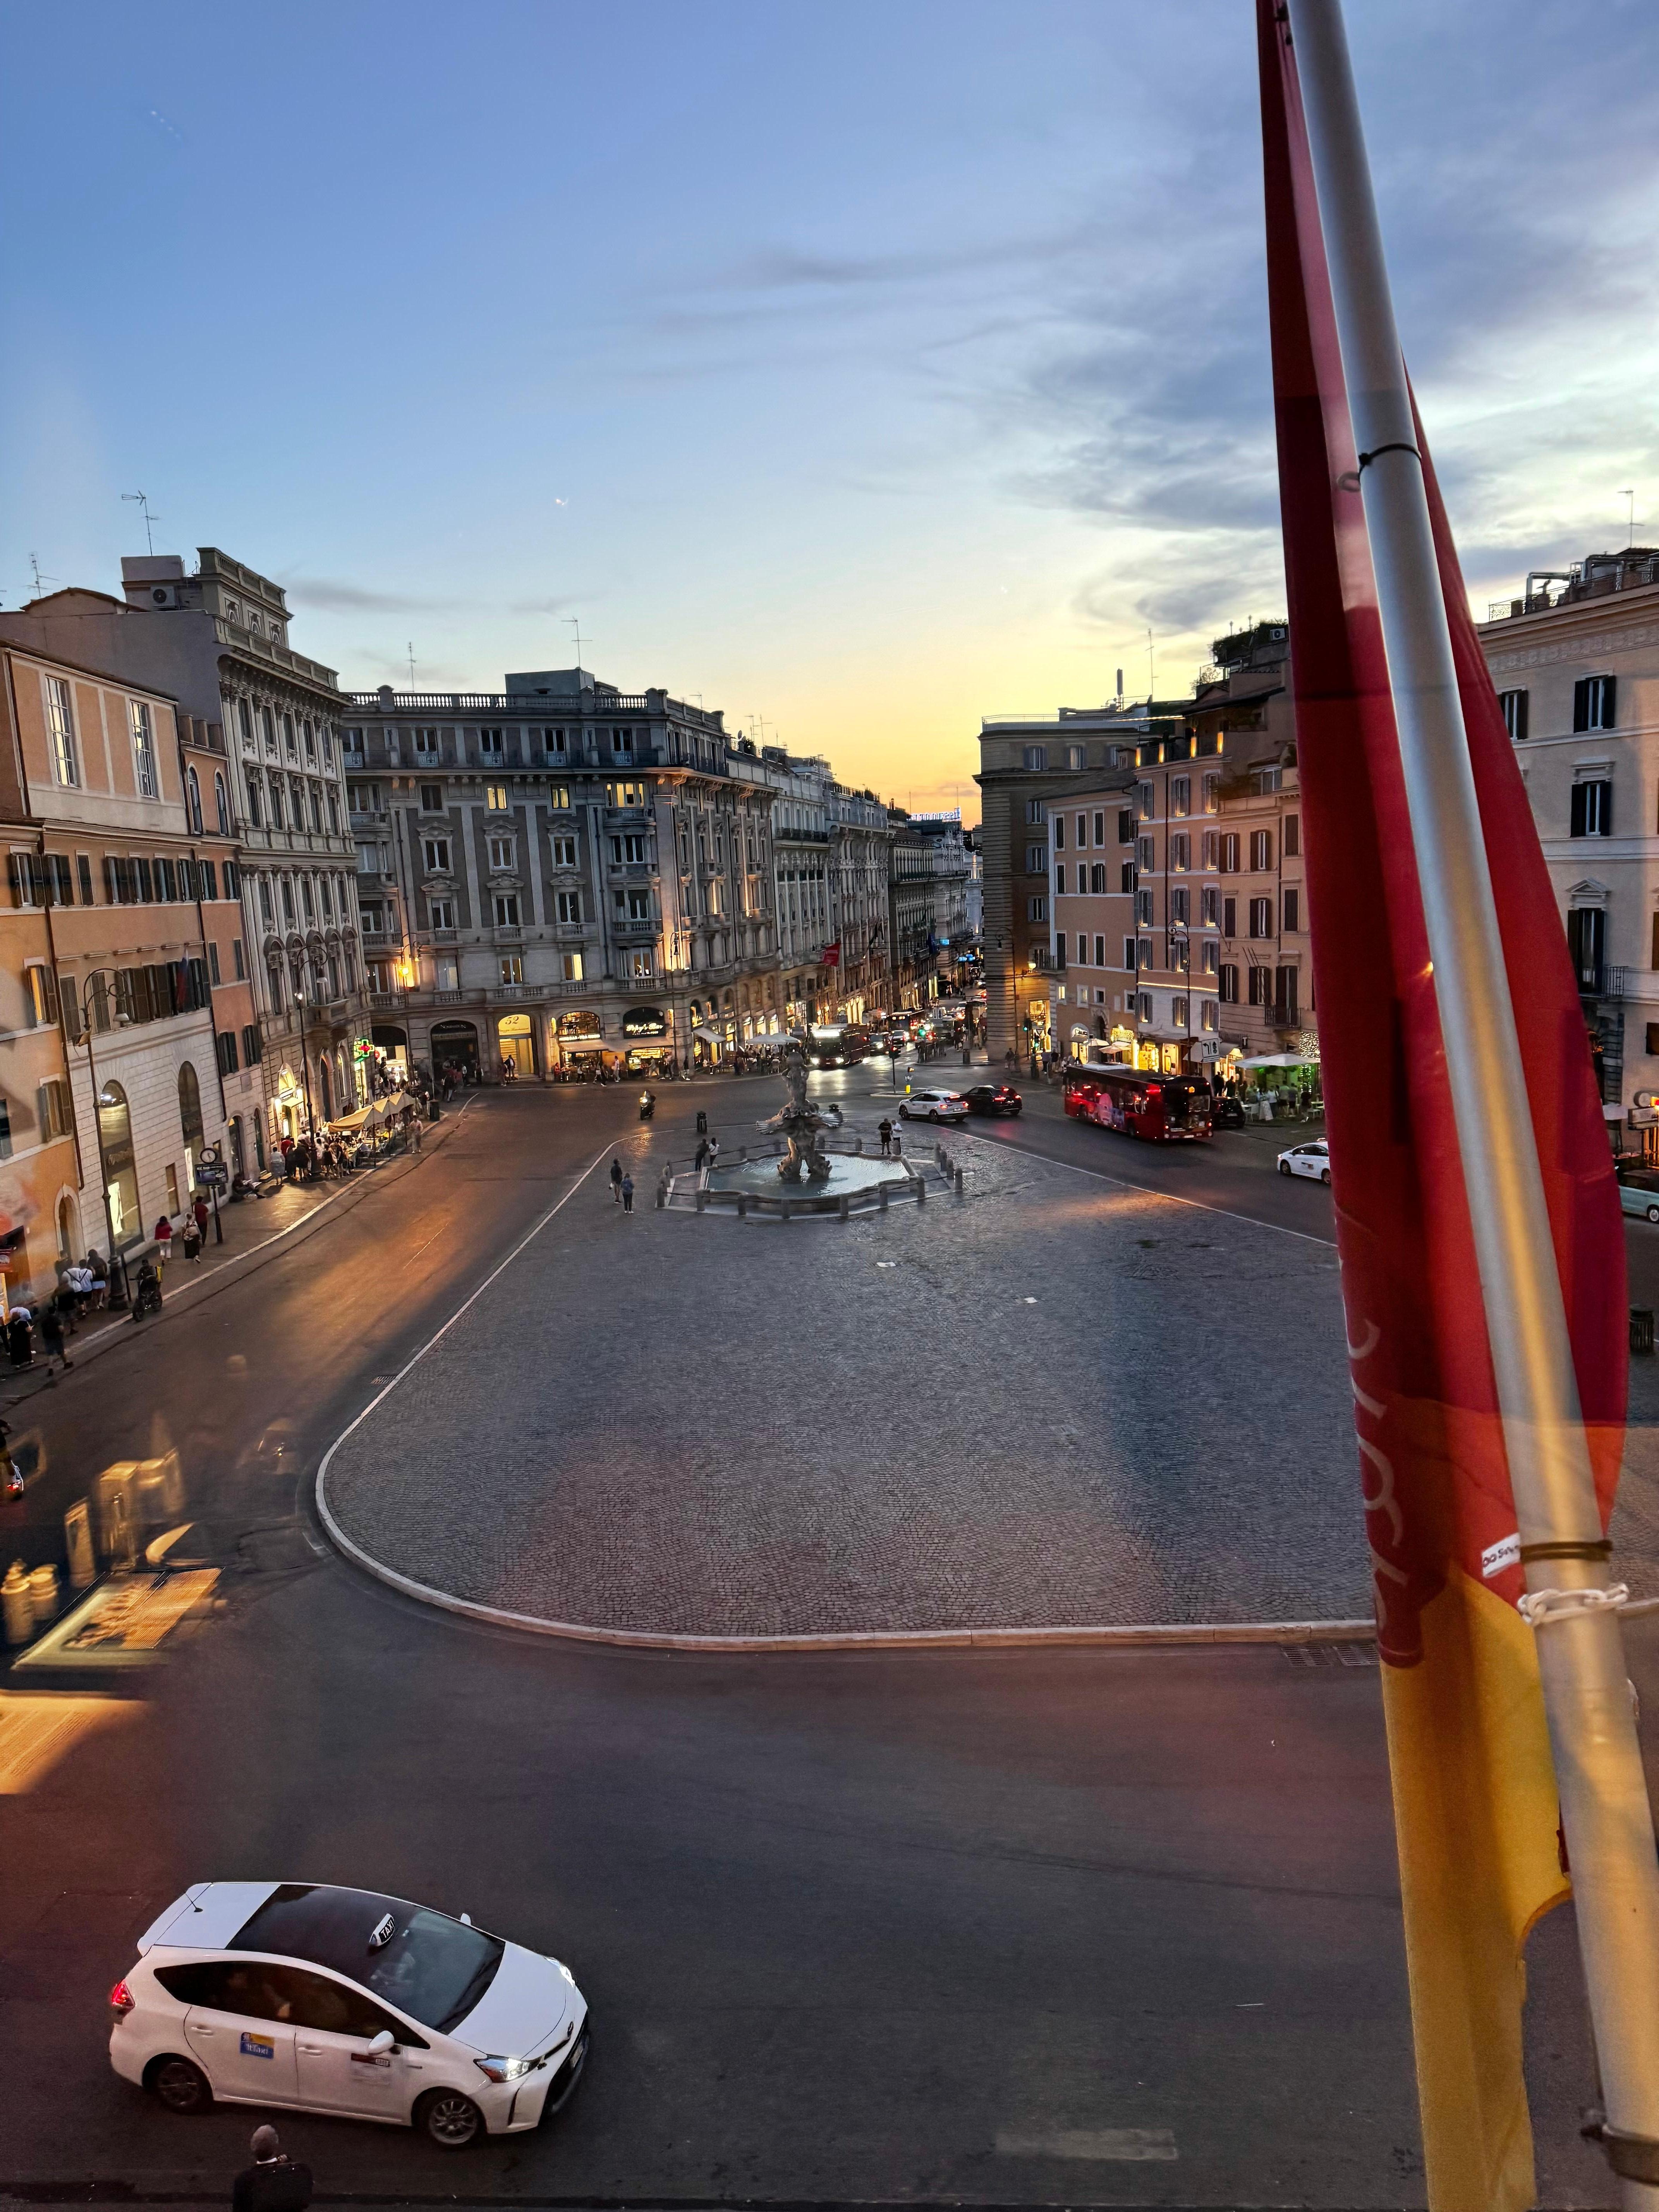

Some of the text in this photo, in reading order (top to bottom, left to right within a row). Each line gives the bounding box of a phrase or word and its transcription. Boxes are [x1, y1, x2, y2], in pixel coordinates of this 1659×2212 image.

[505, 1016, 519, 1024] 52
[1242, 1037, 1247, 1046] T
[381, 1920, 394, 1938] TAXI
